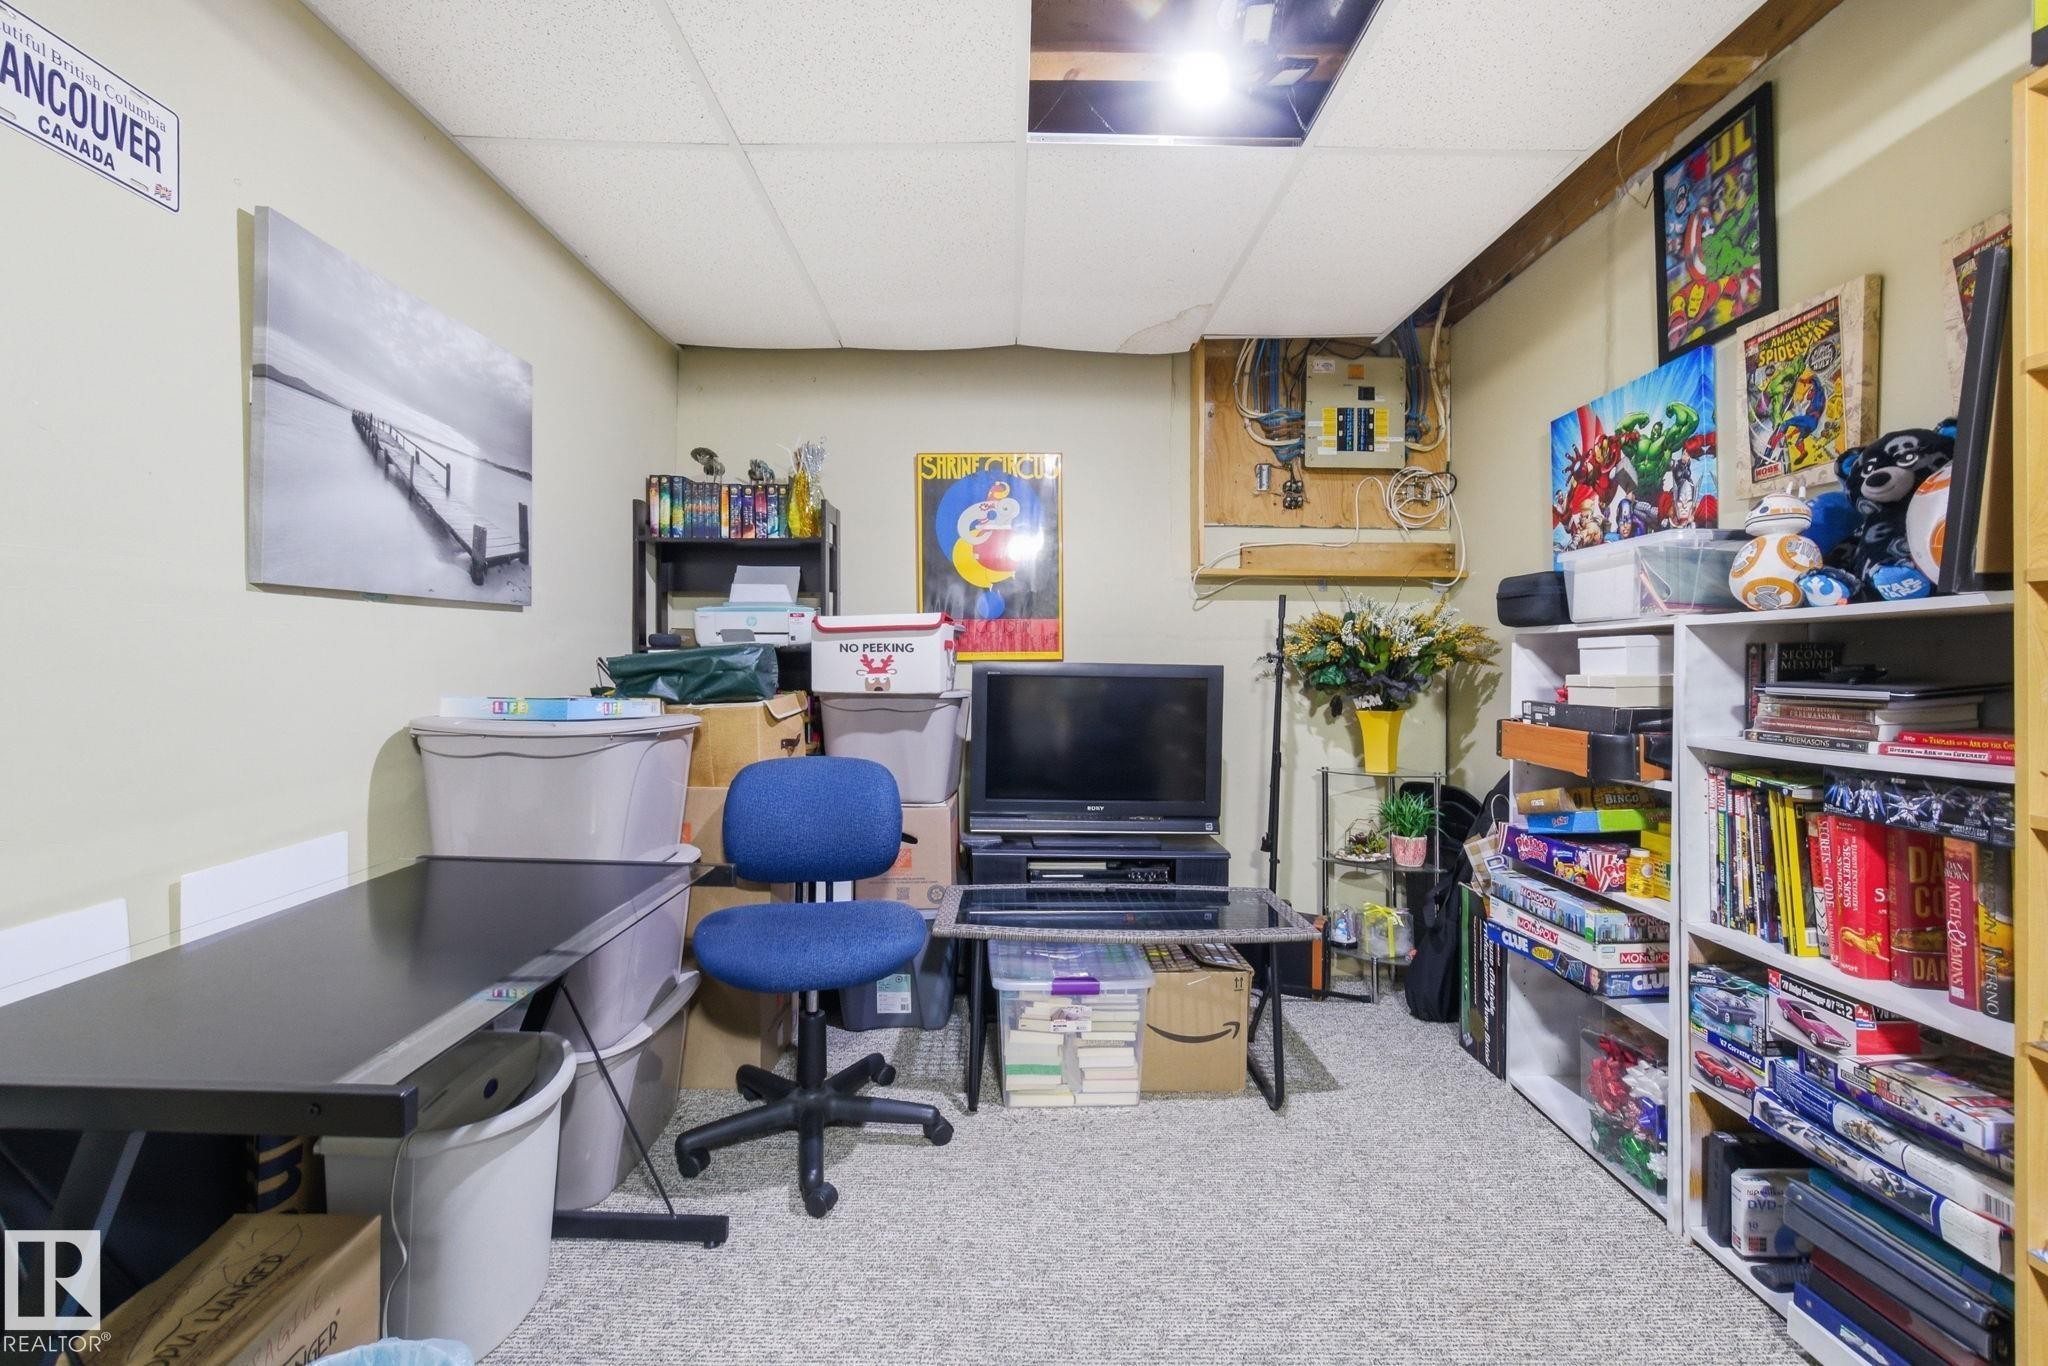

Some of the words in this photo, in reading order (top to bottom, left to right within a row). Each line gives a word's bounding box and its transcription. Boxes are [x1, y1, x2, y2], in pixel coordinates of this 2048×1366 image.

[51, 48, 101, 91] British
[104, 83, 167, 133] Columbia
[38, 115, 115, 171] CANADA
[1758, 318, 1835, 367] SPIDER-MAN
[1771, 321, 1816, 348] AMAZING
[839, 642, 859, 654] NO
[862, 642, 914, 655] PEEKING
[1781, 649, 1834, 660] SECOND
[493, 701, 528, 714] LIFE
[1785, 735, 1830, 748] FREEMASONS
[1604, 794, 1640, 804] BINGO
[1819, 821, 1832, 864] SECRETS
[1843, 845, 1851, 878] SECRET
[1520, 886, 1557, 909] MONOPOLY
[1823, 875, 1834, 908] CODE
[1843, 878, 1852, 908] SIGNS
[1948, 881, 1962, 927] ANGELS
[1502, 930, 1528, 954] CLUE
[1518, 918, 1558, 943] MONOPOLY
[1980, 943, 2001, 1015] INFERNO
